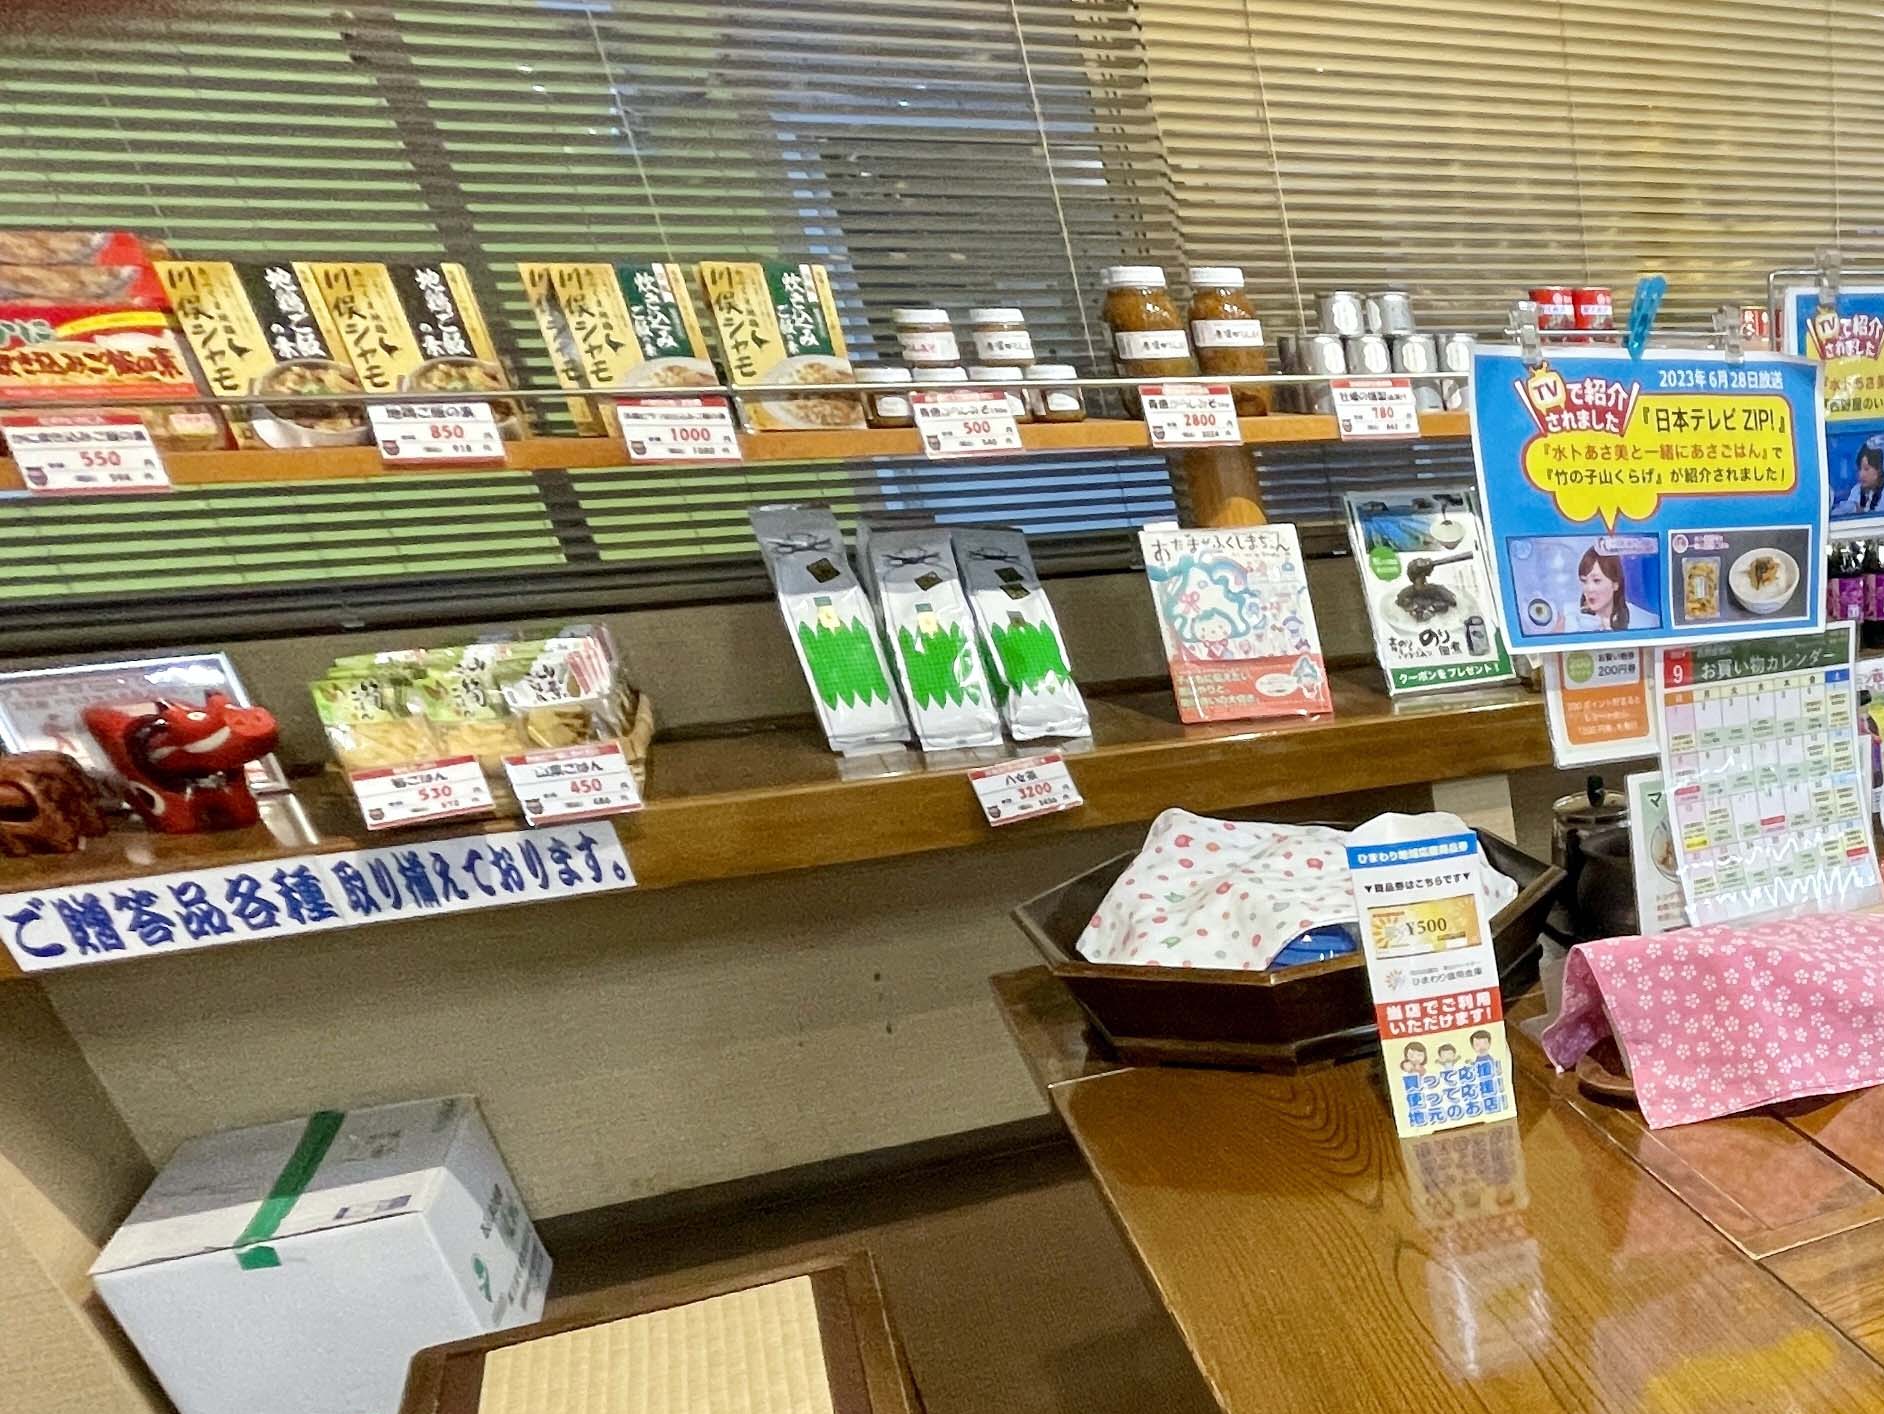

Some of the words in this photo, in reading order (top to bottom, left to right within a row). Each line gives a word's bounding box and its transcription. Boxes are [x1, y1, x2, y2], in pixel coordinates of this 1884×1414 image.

[963, 421, 991, 434] 500
[1184, 414, 1216, 426] 2800
[1545, 410, 1620, 433] されました
[430, 424, 464, 439] 850
[670, 428, 711, 441] 1000
[79, 450, 121, 467] 550
[1400, 663, 1500, 684] クーポンをプレゼント!
[1598, 663, 1636, 677] 200円券
[1672, 664, 1684, 684] 9
[1701, 648, 1835, 681] お買い物カレンダー
[418, 785, 452, 800] 530
[570, 778, 603, 794] 450
[1018, 782, 1052, 799] 3200
[1406, 917, 1447, 936] ¥500
[1386, 991, 1492, 1021] 当店でご利用
[1390, 1007, 1493, 1036] いただけます!
[1402, 1060, 1503, 1092] 買って応援!
[1406, 1077, 1505, 1111] 使って応援!
[1408, 1094, 1509, 1127] 地元のお店!
